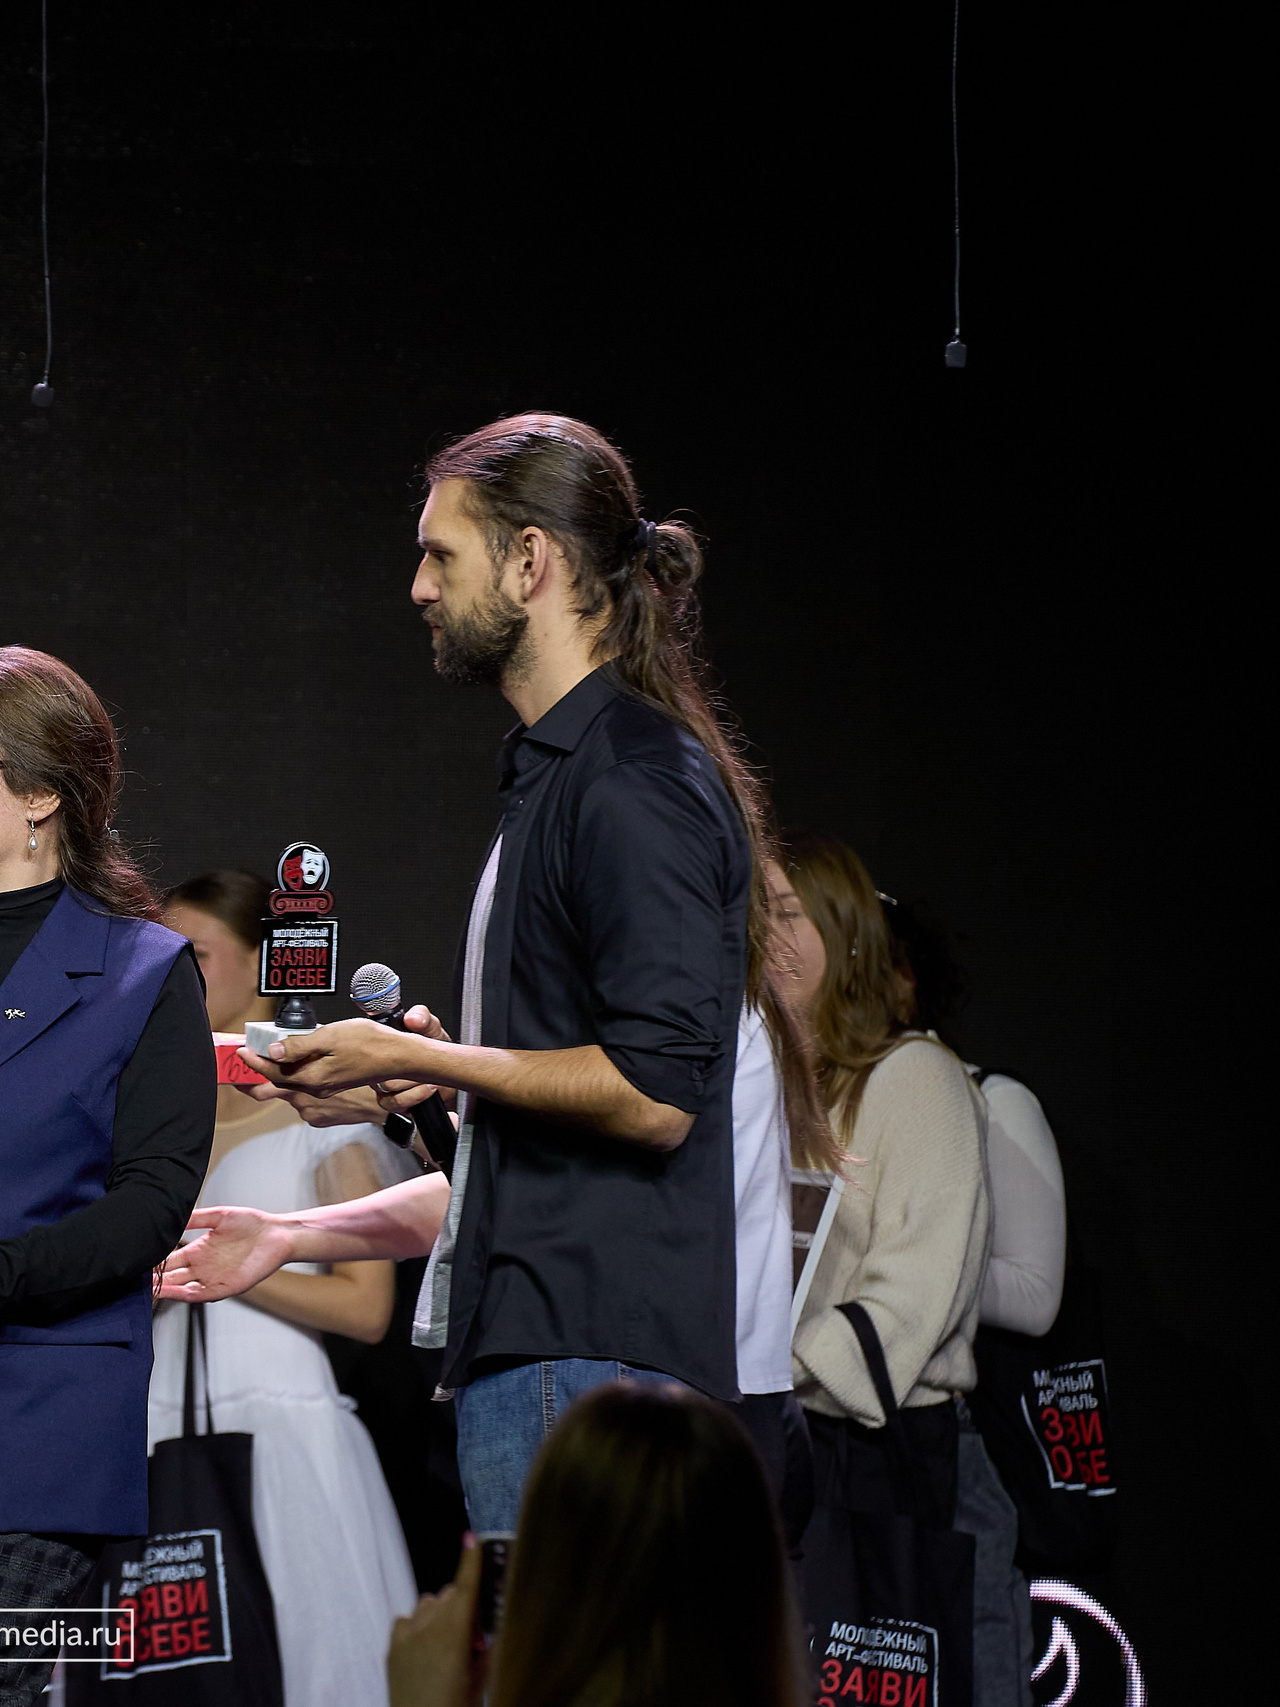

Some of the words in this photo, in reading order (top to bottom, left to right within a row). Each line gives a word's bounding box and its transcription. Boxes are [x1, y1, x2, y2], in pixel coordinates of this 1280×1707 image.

[269, 967, 282, 987] О
[285, 967, 327, 987] СЕБЕ
[270, 948, 328, 967] ЗАЯВИ
[1050, 1444, 1073, 1480] О
[115, 1579, 209, 1632] ЗЯВИ
[136, 1617, 212, 1662] СЕБЕ
[820, 1658, 928, 1707] ЗАЯВИ
